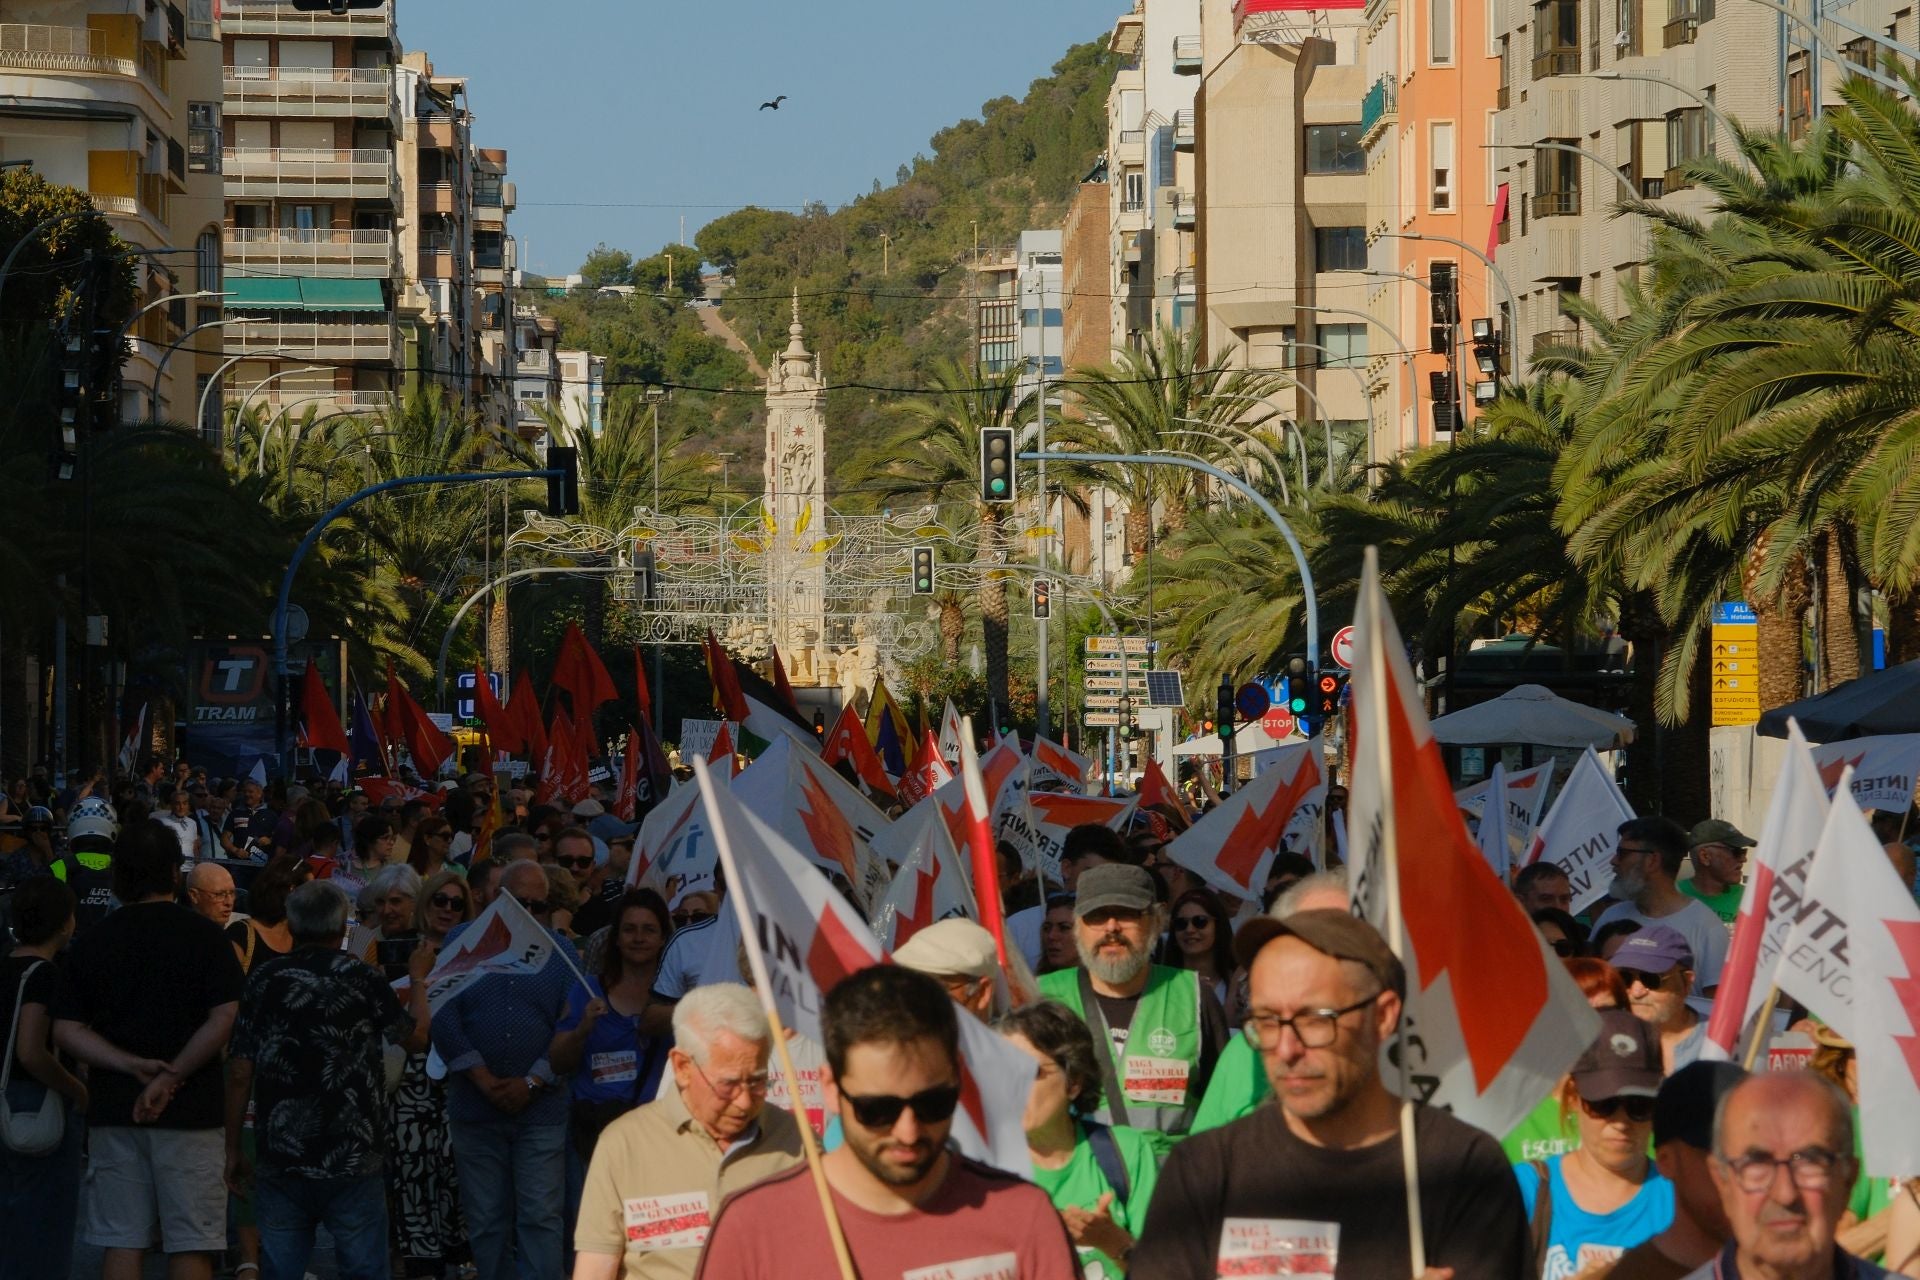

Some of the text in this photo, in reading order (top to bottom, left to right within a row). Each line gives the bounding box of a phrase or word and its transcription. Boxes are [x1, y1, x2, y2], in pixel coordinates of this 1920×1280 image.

[194, 706, 256, 720] TRAM
[1264, 719, 1292, 728] STOP
[629, 1199, 660, 1213] VAGA
[647, 1200, 705, 1220] GENERAL
